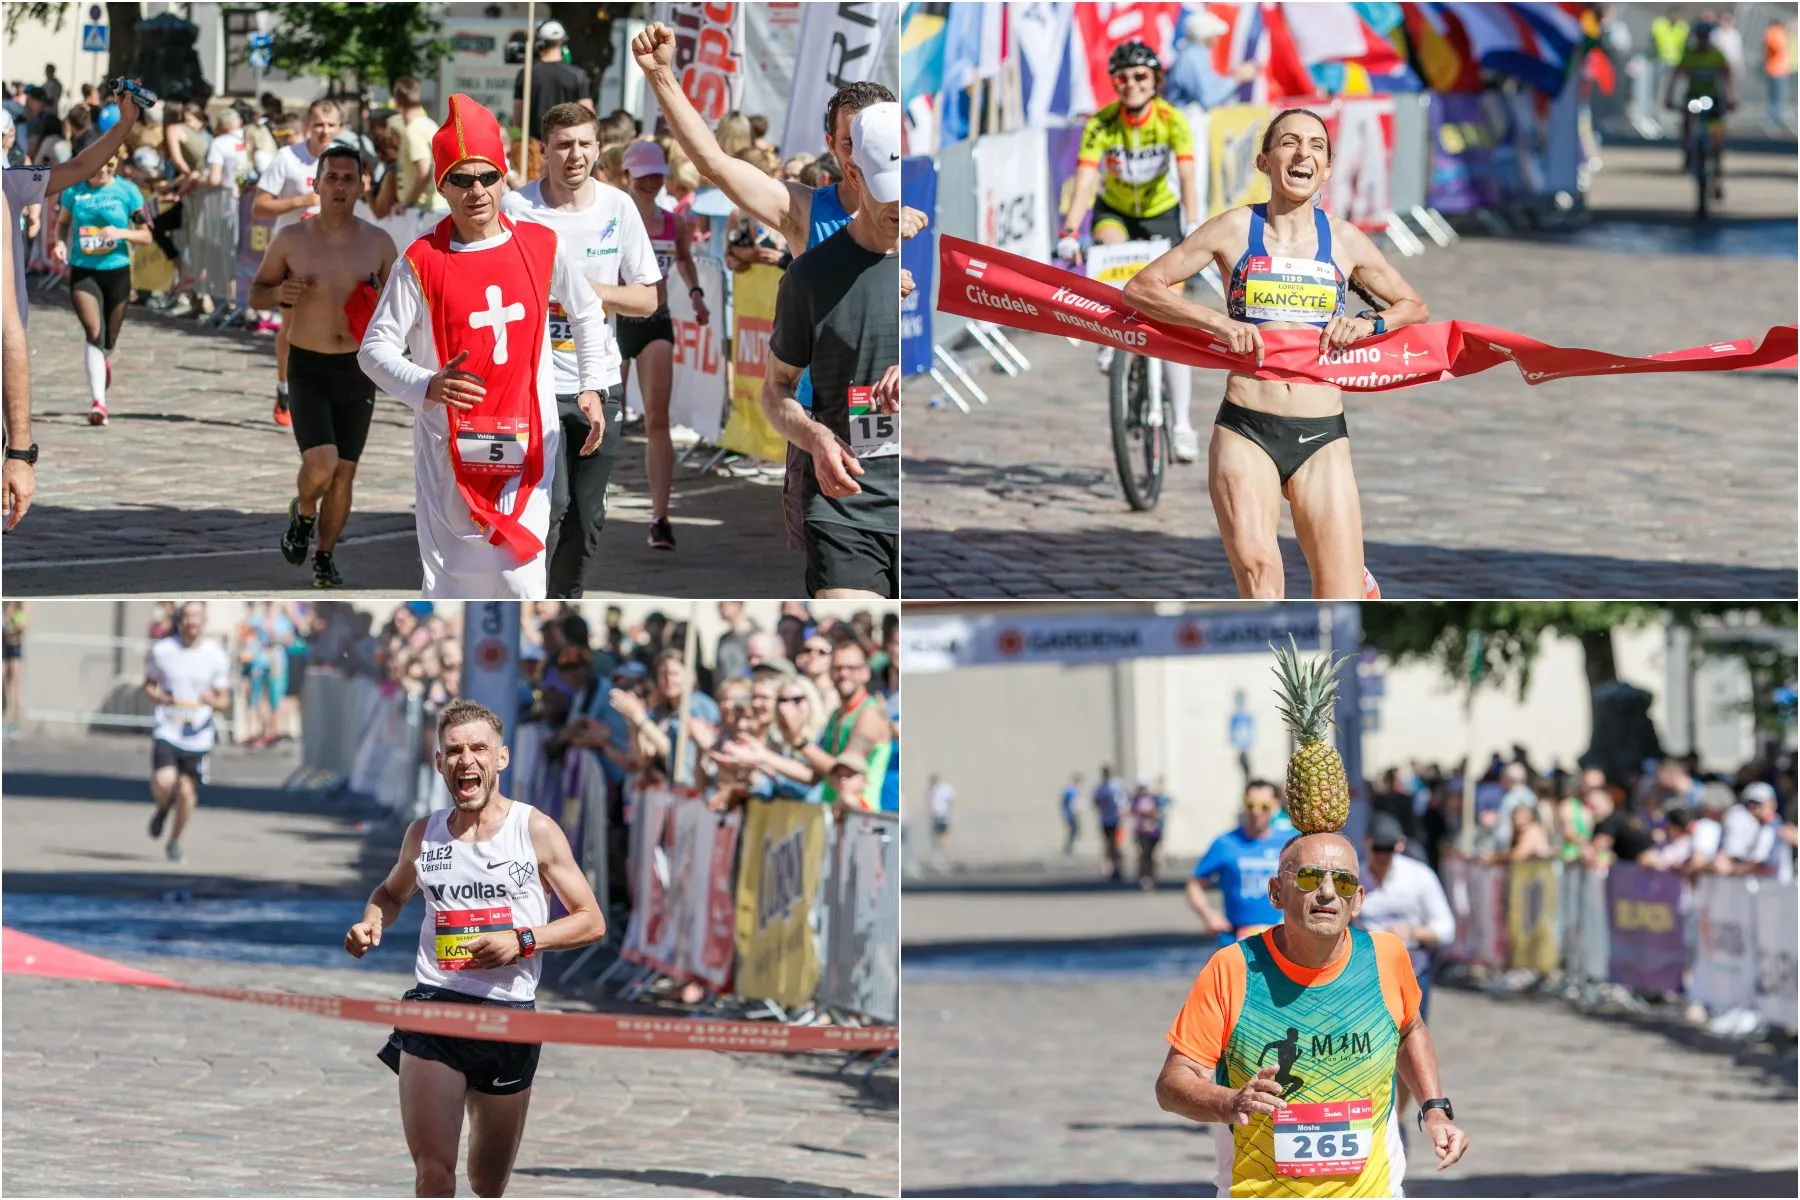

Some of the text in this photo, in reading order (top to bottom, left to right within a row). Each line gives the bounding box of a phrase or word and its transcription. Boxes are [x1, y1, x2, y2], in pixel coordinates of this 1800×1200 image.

[1278, 283, 1304, 291] LORETA
[1281, 274, 1303, 283] 1190
[965, 284, 1039, 316] Citadele
[1051, 286, 1112, 314] Kauno
[1253, 291, 1328, 308] KANČYTĖ
[1053, 309, 1147, 347] maratonas
[488, 443, 505, 462] 5
[421, 845, 453, 862] TELE2
[421, 861, 452, 872] Verslui
[449, 882, 507, 899] voltas
[463, 926, 480, 934] 266
[1297, 1124, 1320, 1132] Moshe
[1292, 1133, 1359, 1159] 265
